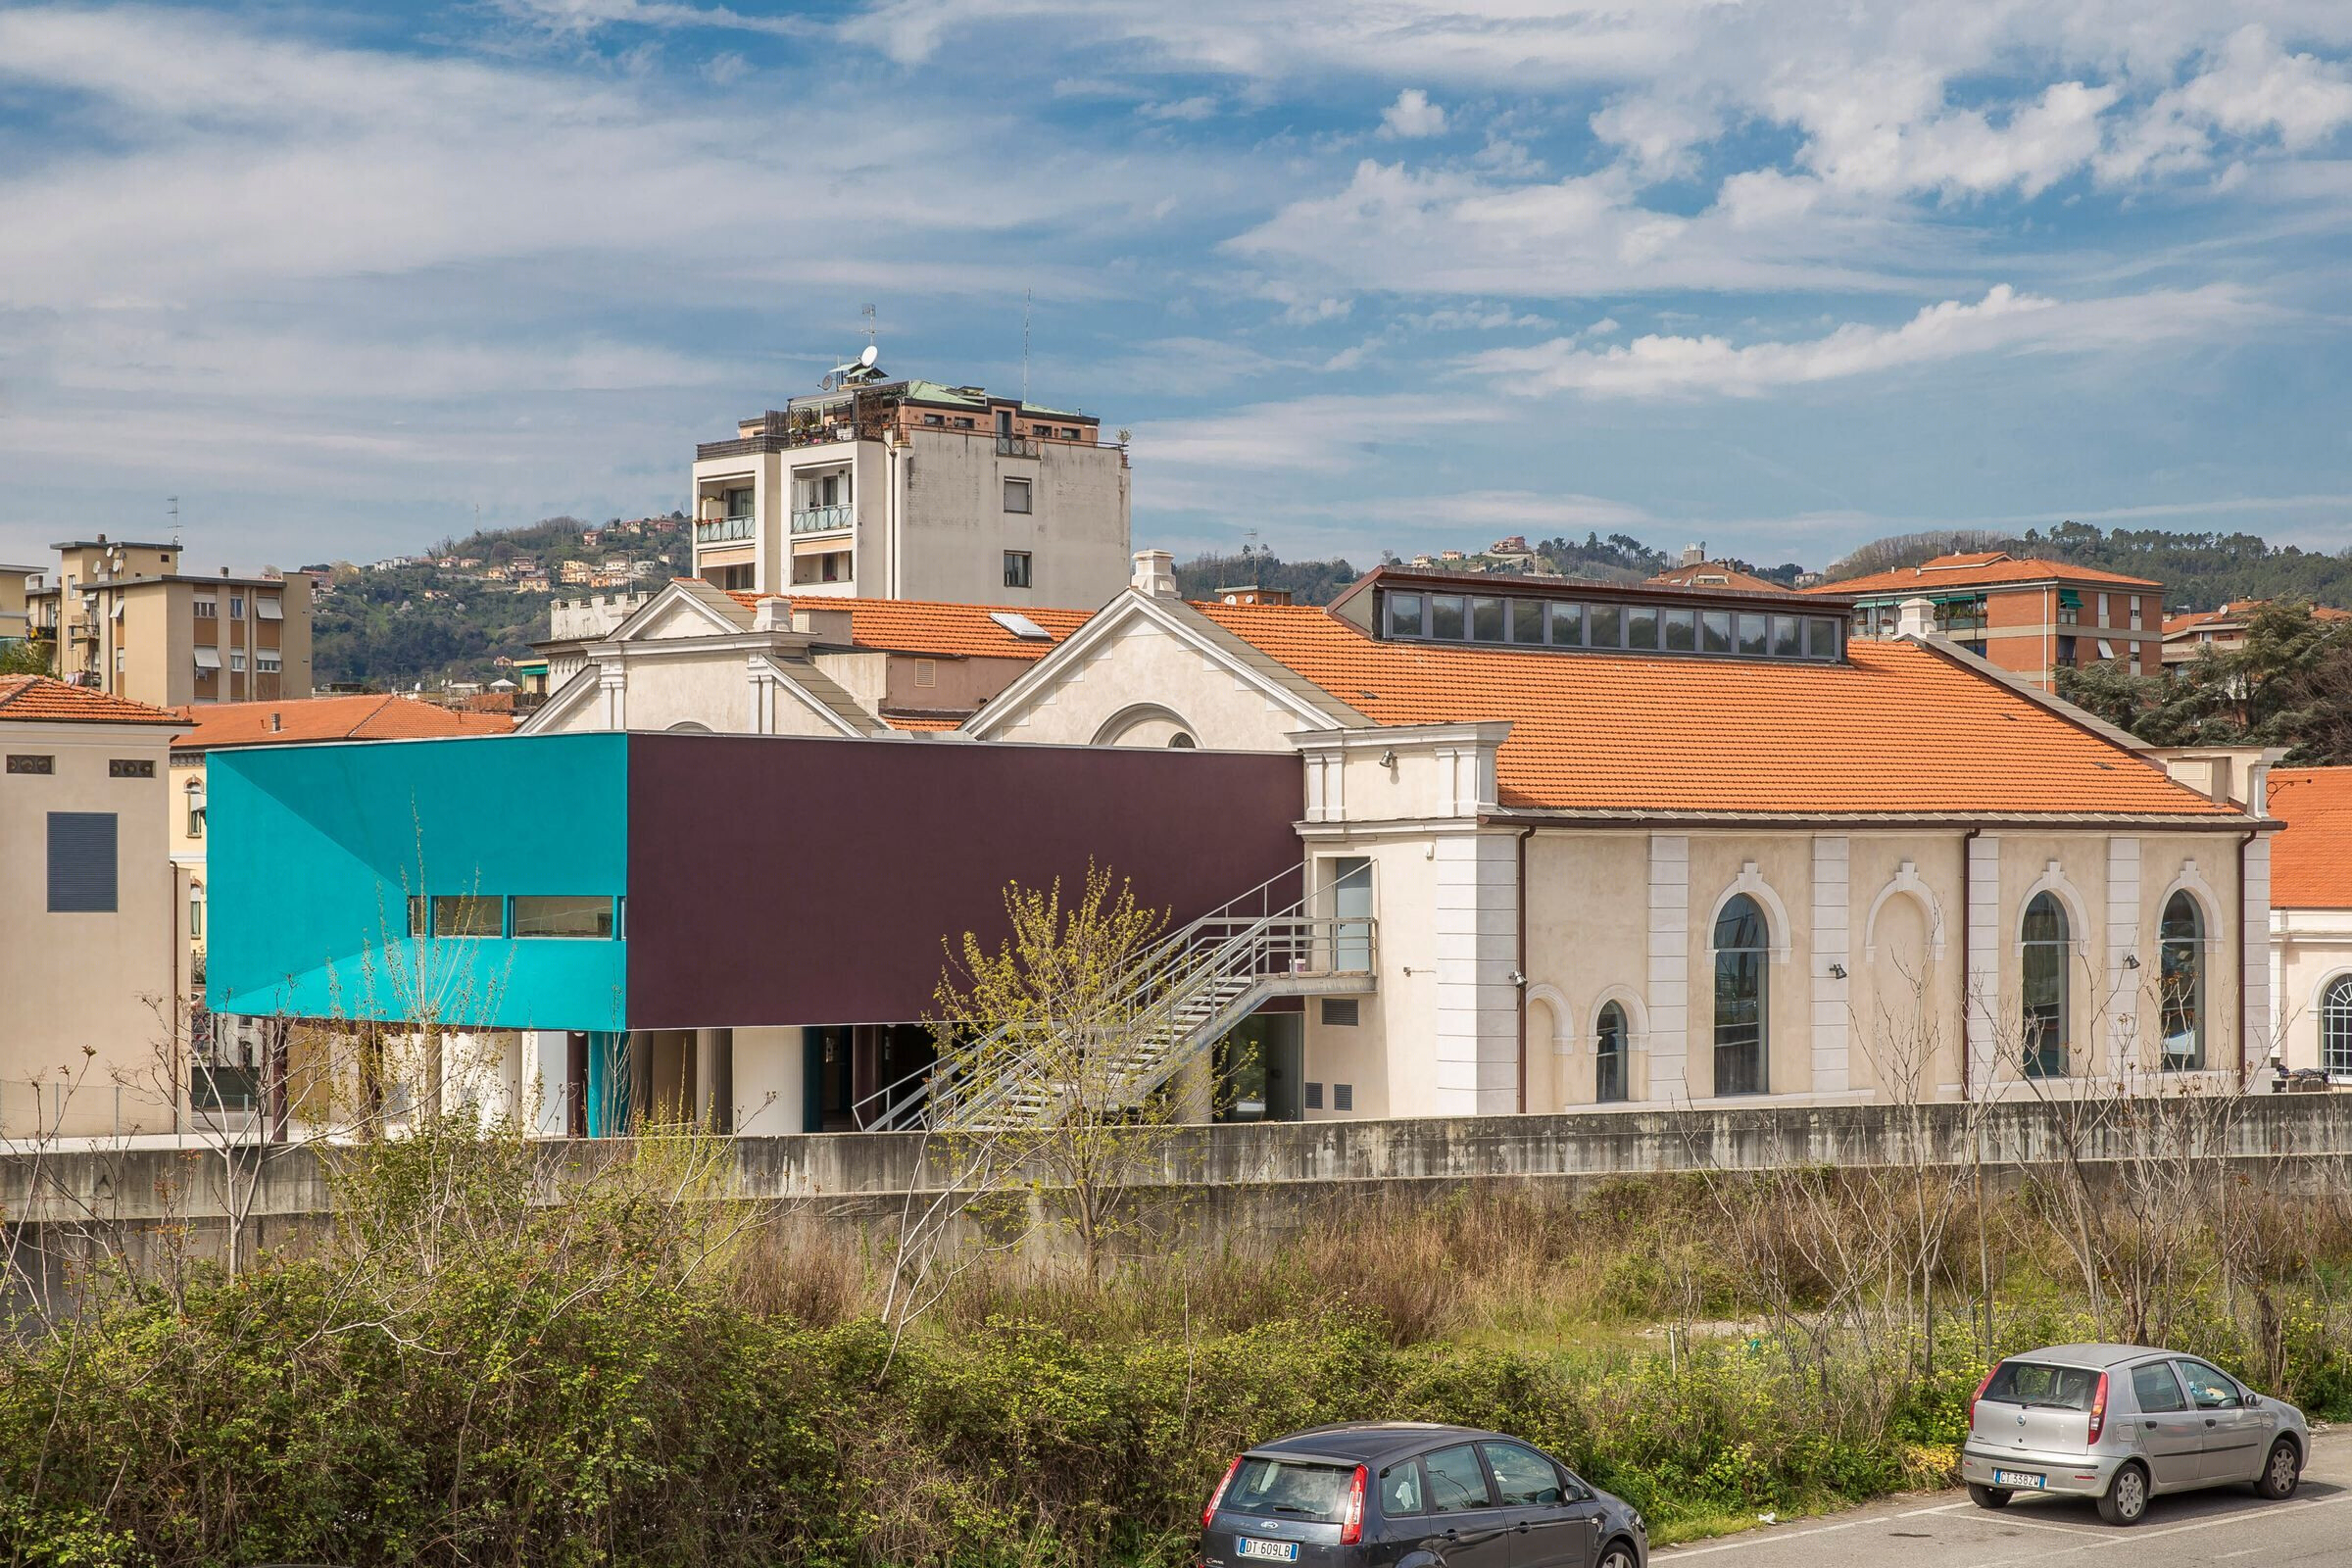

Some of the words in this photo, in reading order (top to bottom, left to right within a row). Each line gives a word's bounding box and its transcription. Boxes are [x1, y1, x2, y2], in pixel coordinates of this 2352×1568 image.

[2001, 1472, 2010, 1482] CT
[2013, 1474, 2039, 1486] 338ZW
[1246, 1541, 1258, 1553] DT
[1261, 1543, 1290, 1557] 609LB
